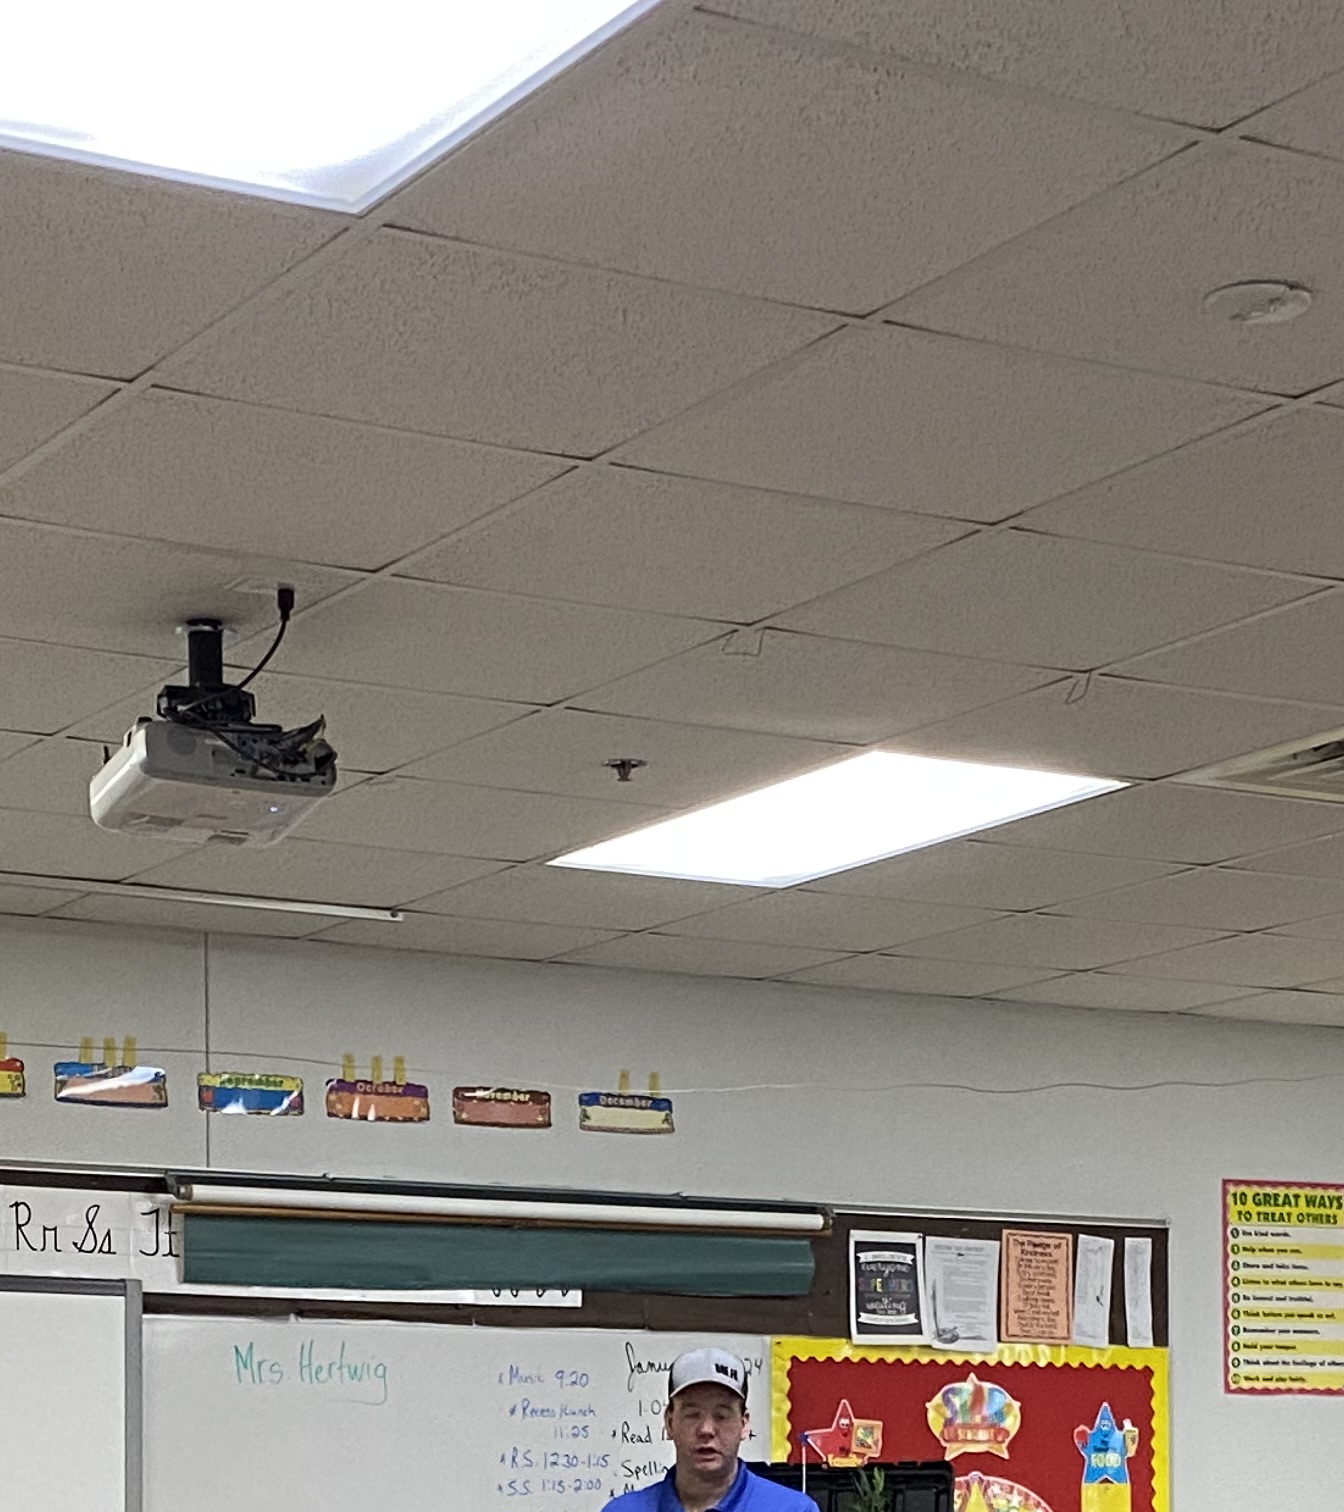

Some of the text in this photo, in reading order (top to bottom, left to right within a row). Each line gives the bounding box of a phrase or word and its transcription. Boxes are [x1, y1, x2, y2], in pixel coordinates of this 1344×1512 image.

[356, 1082, 404, 1095] October
[599, 1094, 653, 1108] December
[1231, 1191, 1343, 1210] 10 GREAT WAYS
[1237, 1210, 1338, 1225] TO TREAT OTHERS
[234, 1339, 388, 1405] Mrs Hertwig
[621, 1420, 653, 1444] Read
